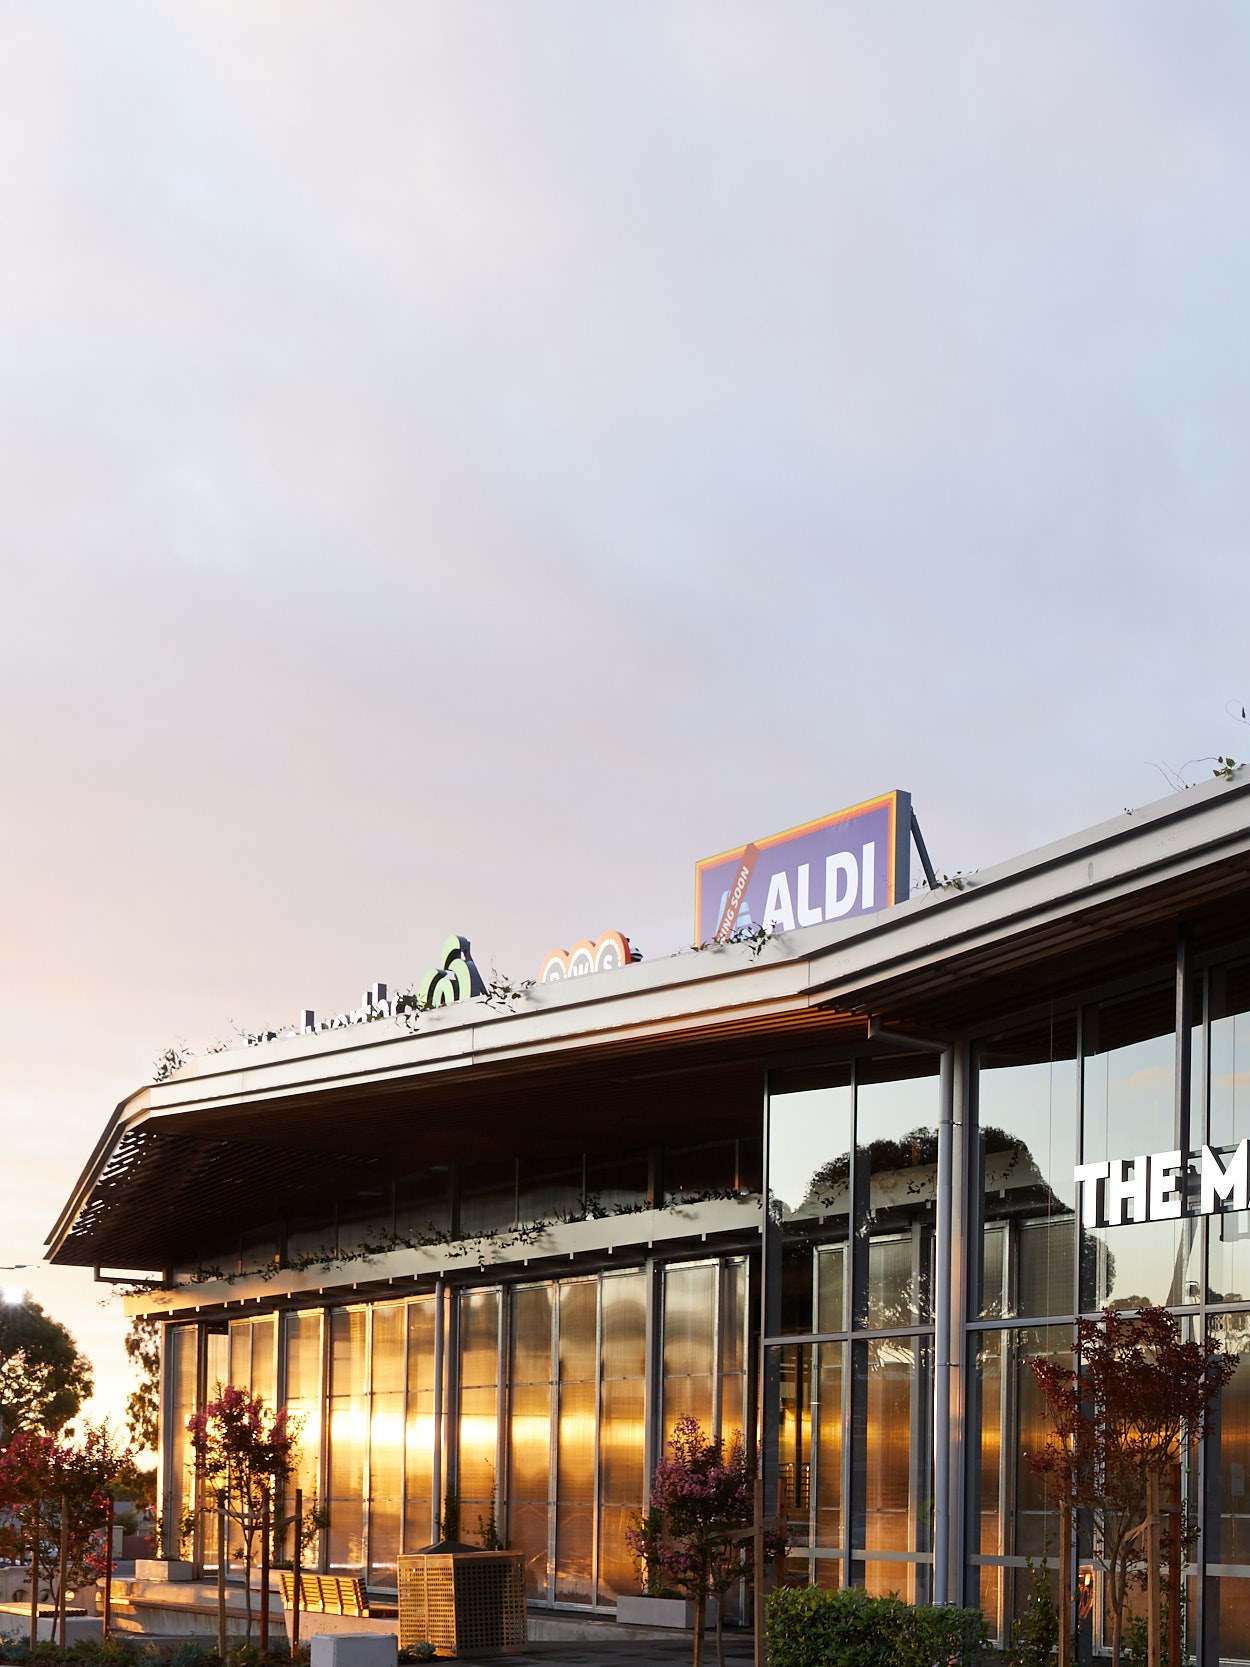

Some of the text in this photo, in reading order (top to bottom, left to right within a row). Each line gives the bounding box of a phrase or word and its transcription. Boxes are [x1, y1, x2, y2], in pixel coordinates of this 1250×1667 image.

[731, 865, 750, 909] SOON
[762, 841, 876, 935] ALDI
[1073, 1149, 1182, 1229] THE
